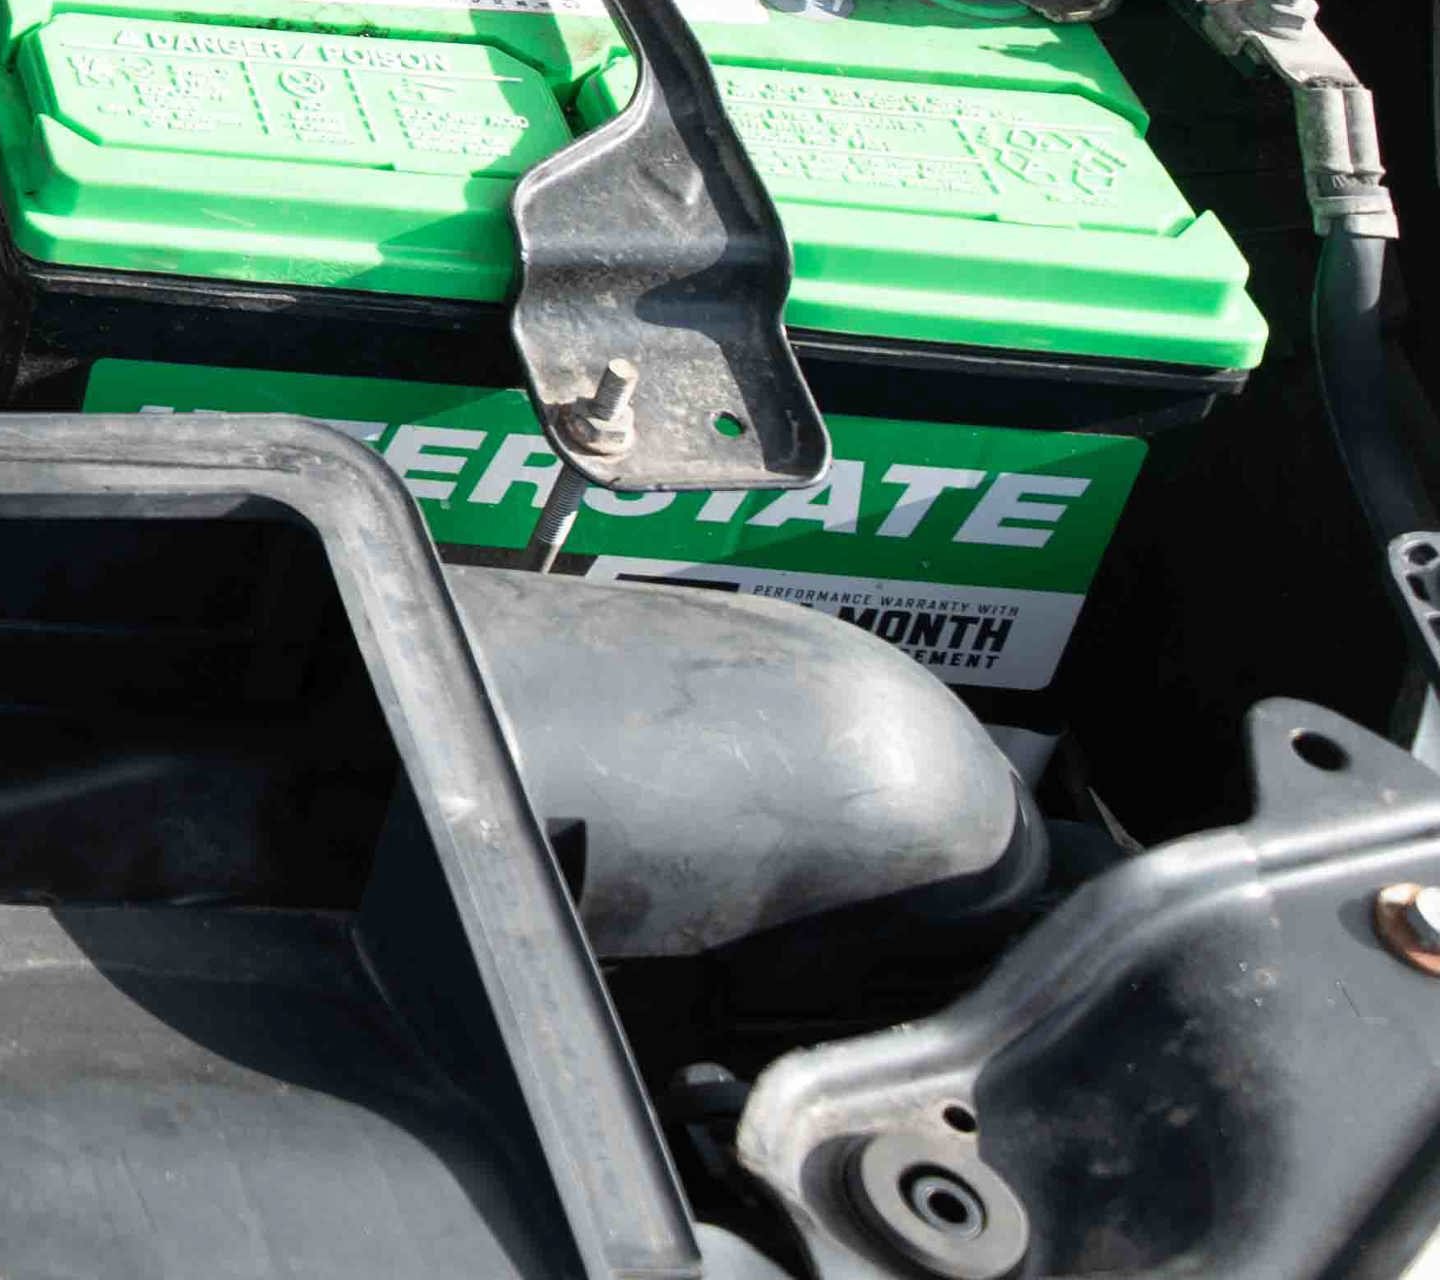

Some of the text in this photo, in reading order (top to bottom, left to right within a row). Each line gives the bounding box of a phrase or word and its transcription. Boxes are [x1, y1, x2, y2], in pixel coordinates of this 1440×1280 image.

[146, 30, 294, 59] DANGER
[319, 45, 448, 72] POISON
[751, 584, 874, 606] PERFORMANCE
[879, 595, 971, 613] WARRANTY
[977, 603, 1021, 617] WITH
[836, 606, 1015, 653] MONTH
